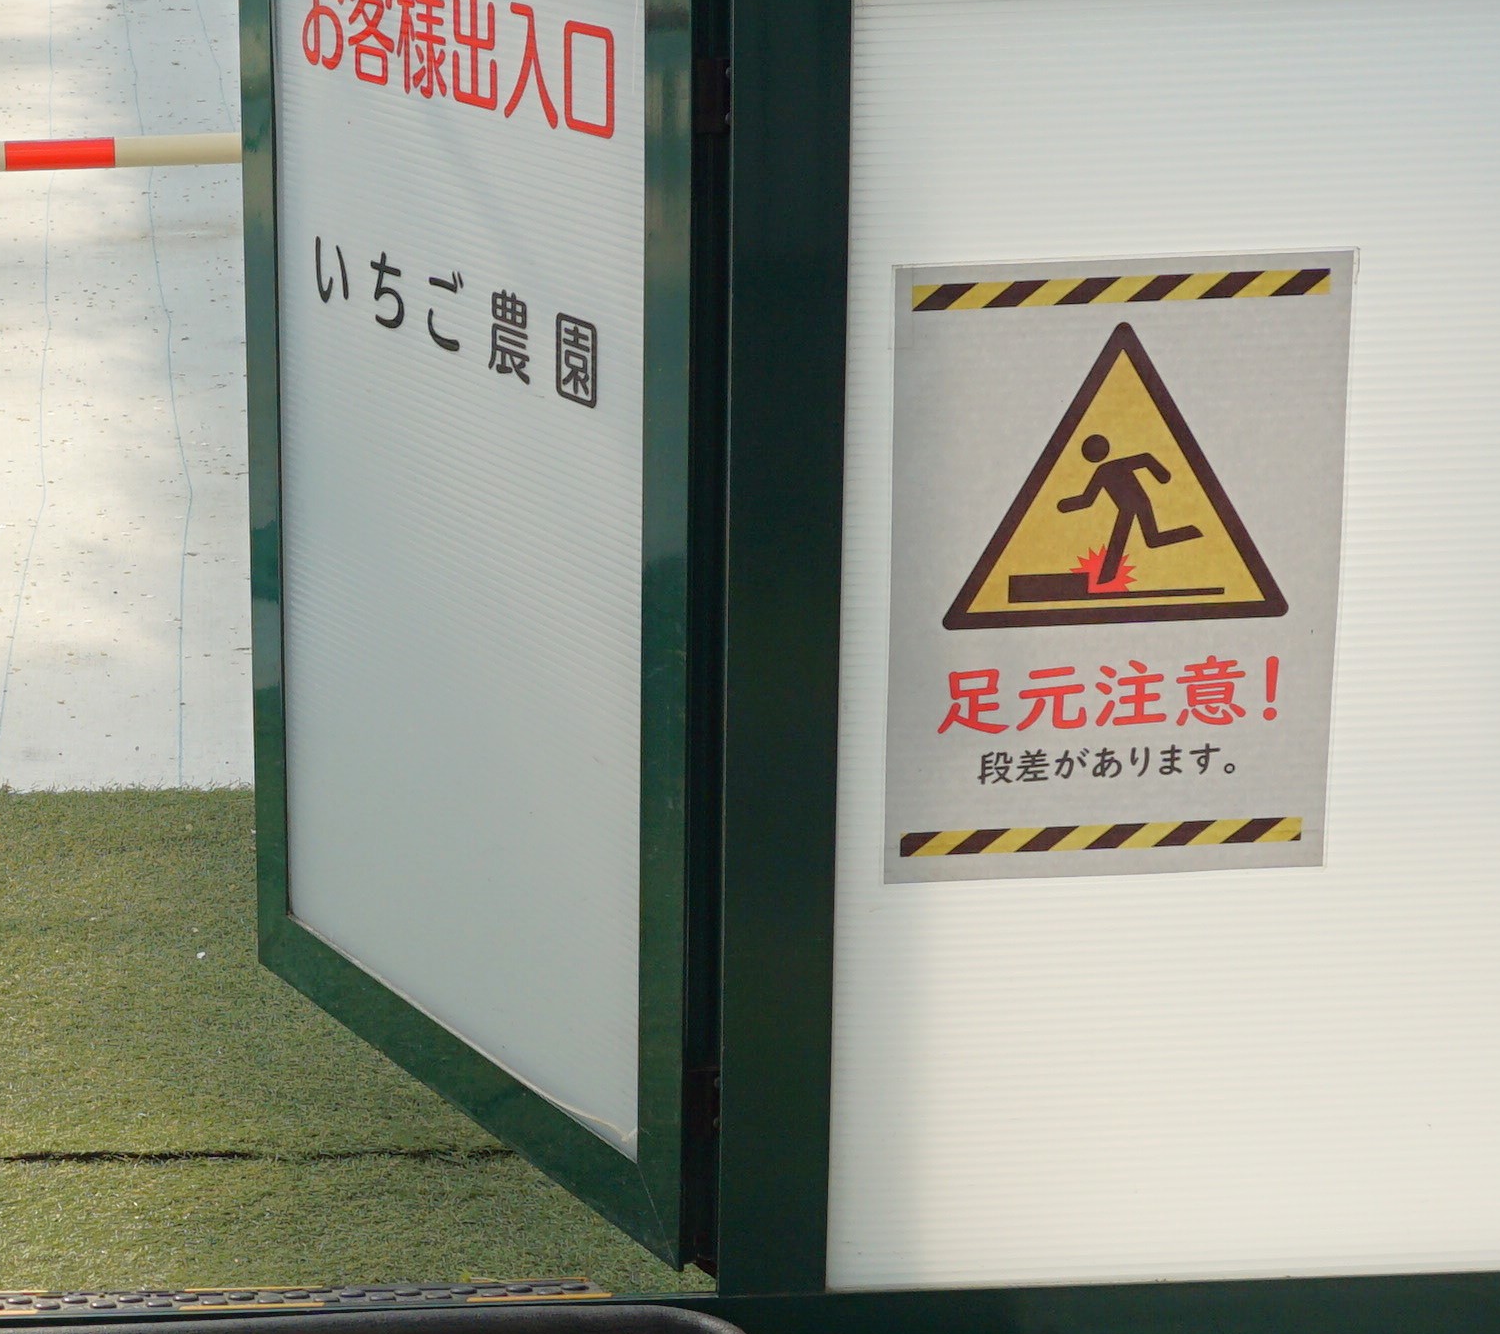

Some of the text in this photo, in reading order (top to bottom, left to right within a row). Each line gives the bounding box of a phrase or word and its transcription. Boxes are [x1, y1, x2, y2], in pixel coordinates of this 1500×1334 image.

[314, 234, 598, 409] いちご農園
[936, 654, 1281, 736] 足元注意！
[976, 742, 1238, 785] 段差があります。
